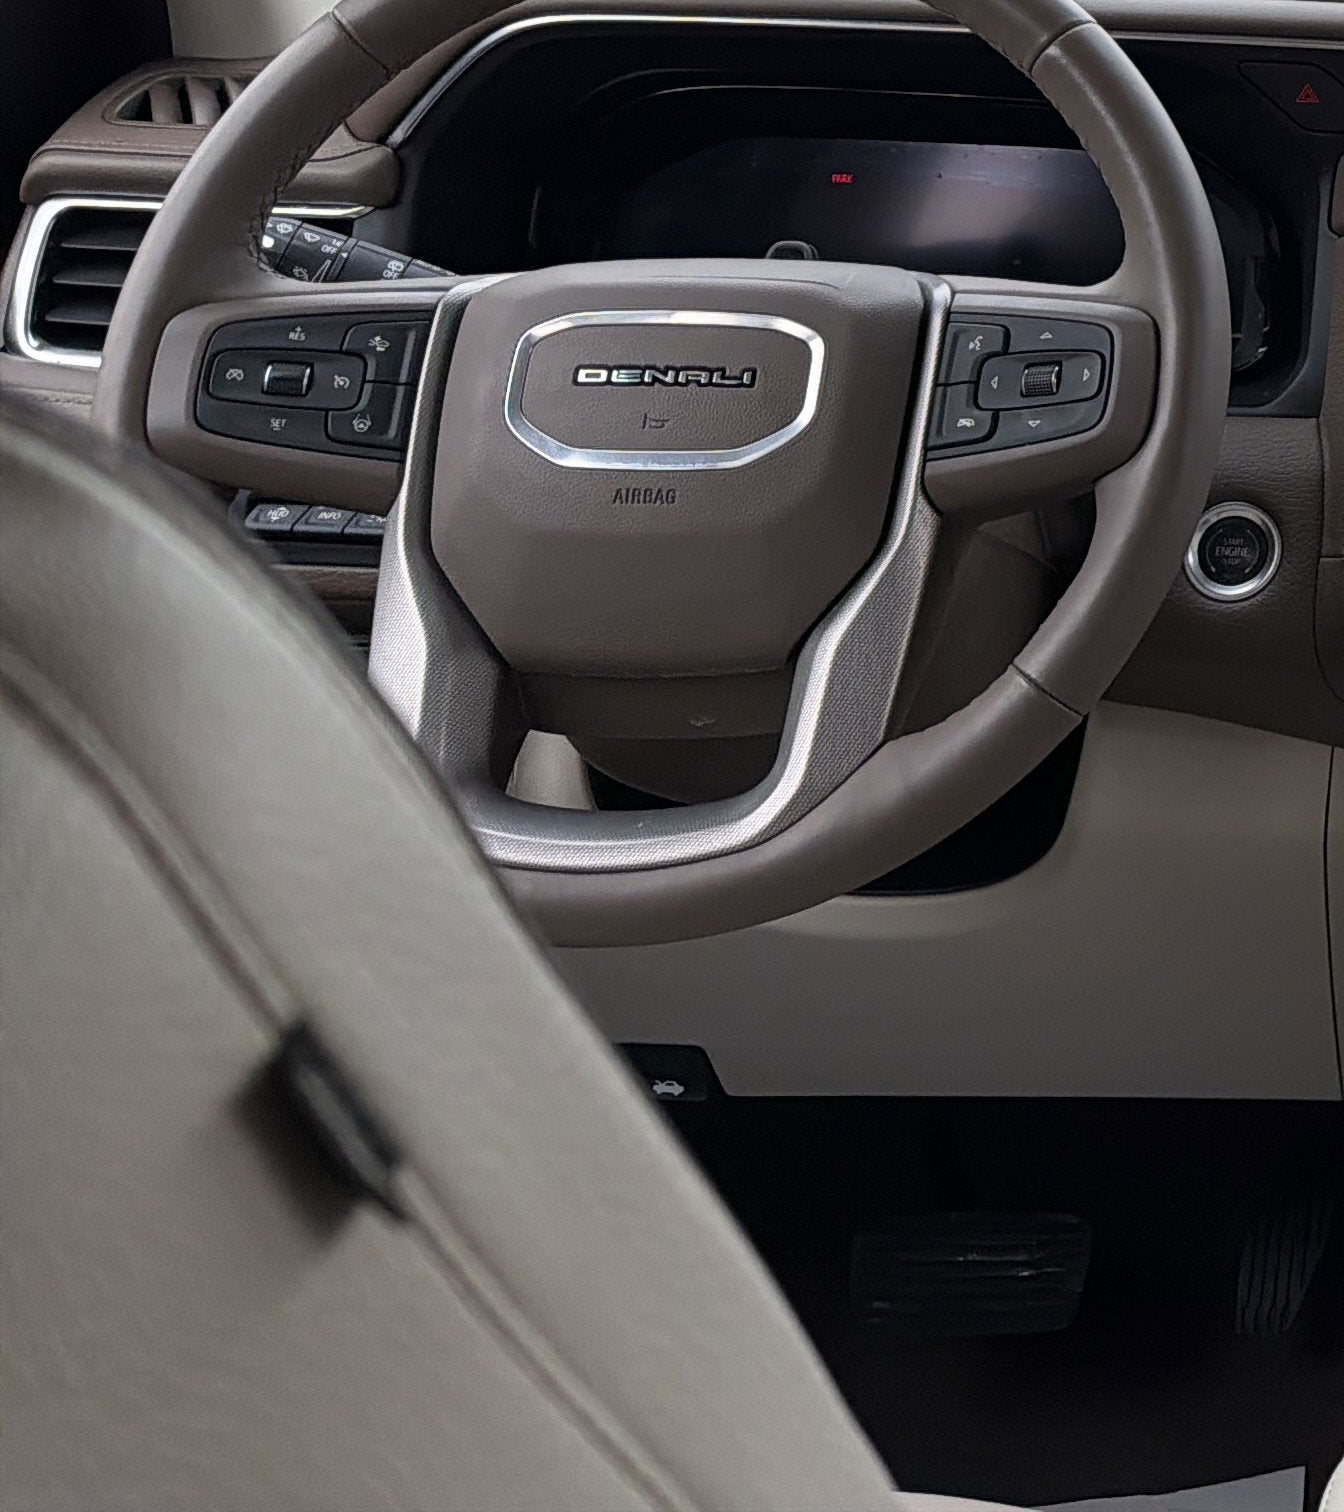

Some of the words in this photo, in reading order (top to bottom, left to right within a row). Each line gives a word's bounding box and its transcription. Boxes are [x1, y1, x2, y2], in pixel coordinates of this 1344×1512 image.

[321, 245, 338, 255] OFF
[383, 269, 400, 280] OFF
[288, 332, 306, 341] RES
[575, 366, 755, 386] DENALI
[270, 418, 286, 428] SET
[610, 487, 677, 505] AIRBAG
[317, 511, 342, 520] INFO
[1215, 546, 1249, 557] ENGINE
